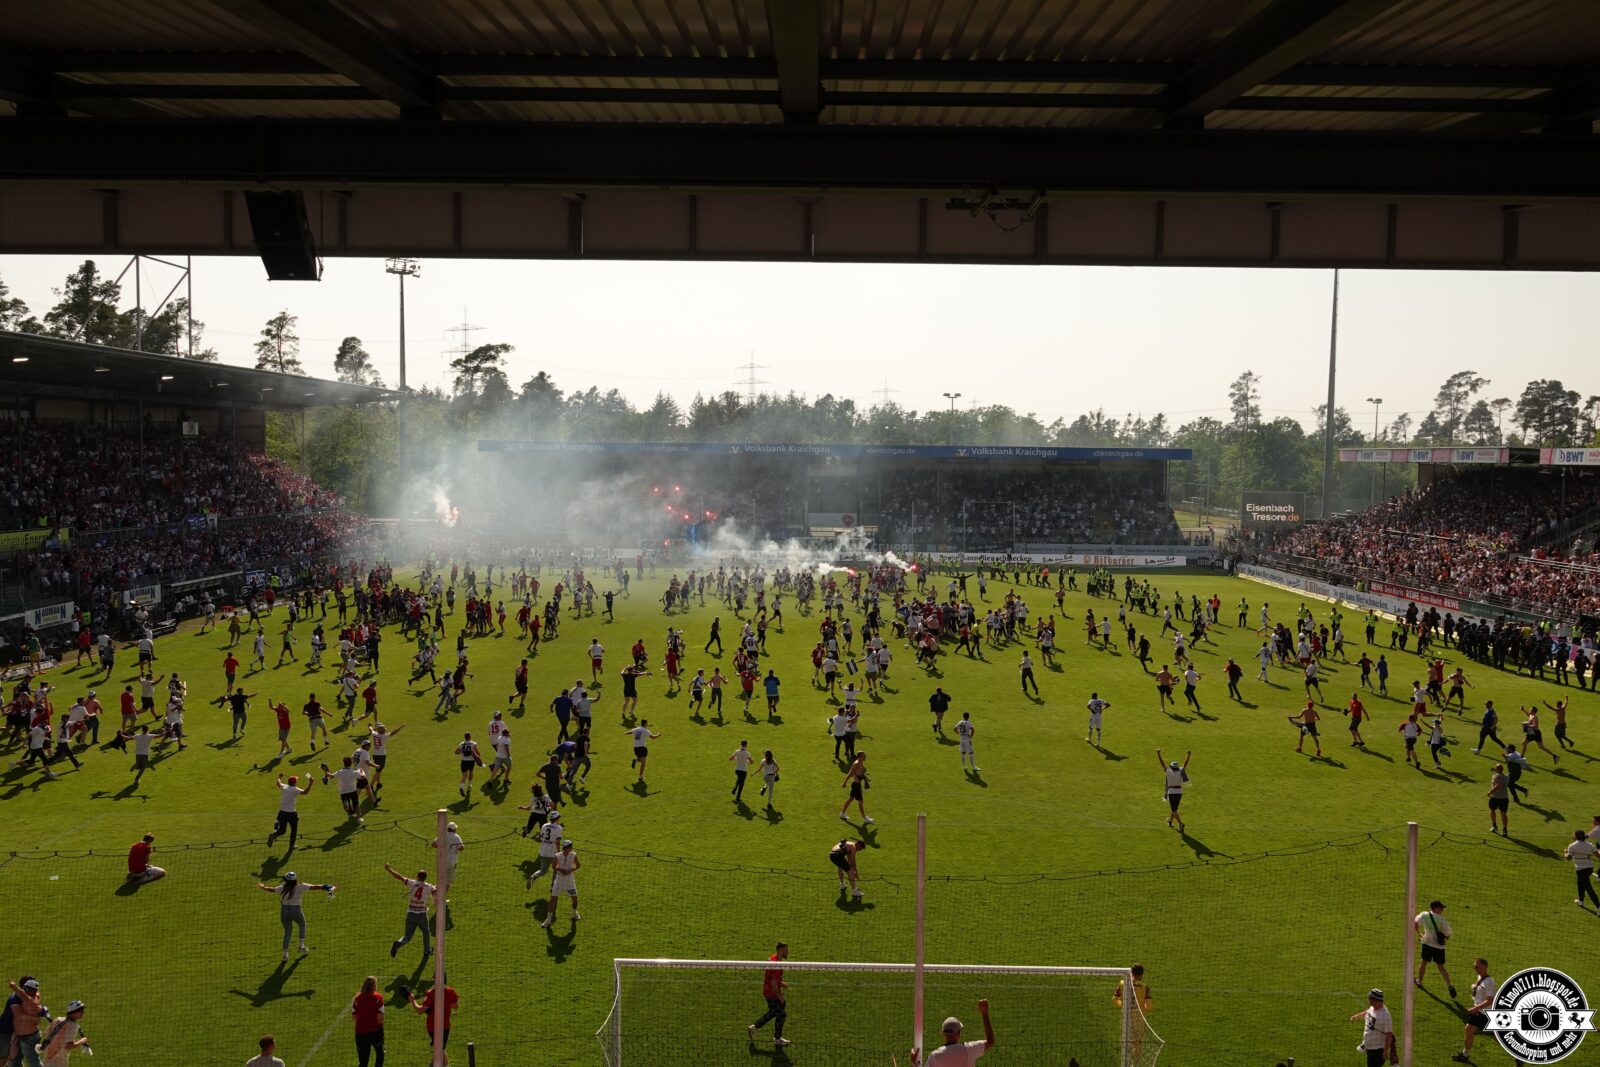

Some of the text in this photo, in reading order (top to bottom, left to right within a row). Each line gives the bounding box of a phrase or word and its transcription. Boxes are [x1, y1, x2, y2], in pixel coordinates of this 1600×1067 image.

[744, 444, 831, 454] Volksbank Kraichgau
[971, 447, 1058, 458] Volksbank Kraichgau
[1566, 451, 1584, 463] BWT
[1246, 503, 1295, 512] Eisenbach
[1251, 512, 1301, 521] Tresore.de
[1094, 555, 1135, 566] Bitburger
[413, 886, 424, 901] 4
